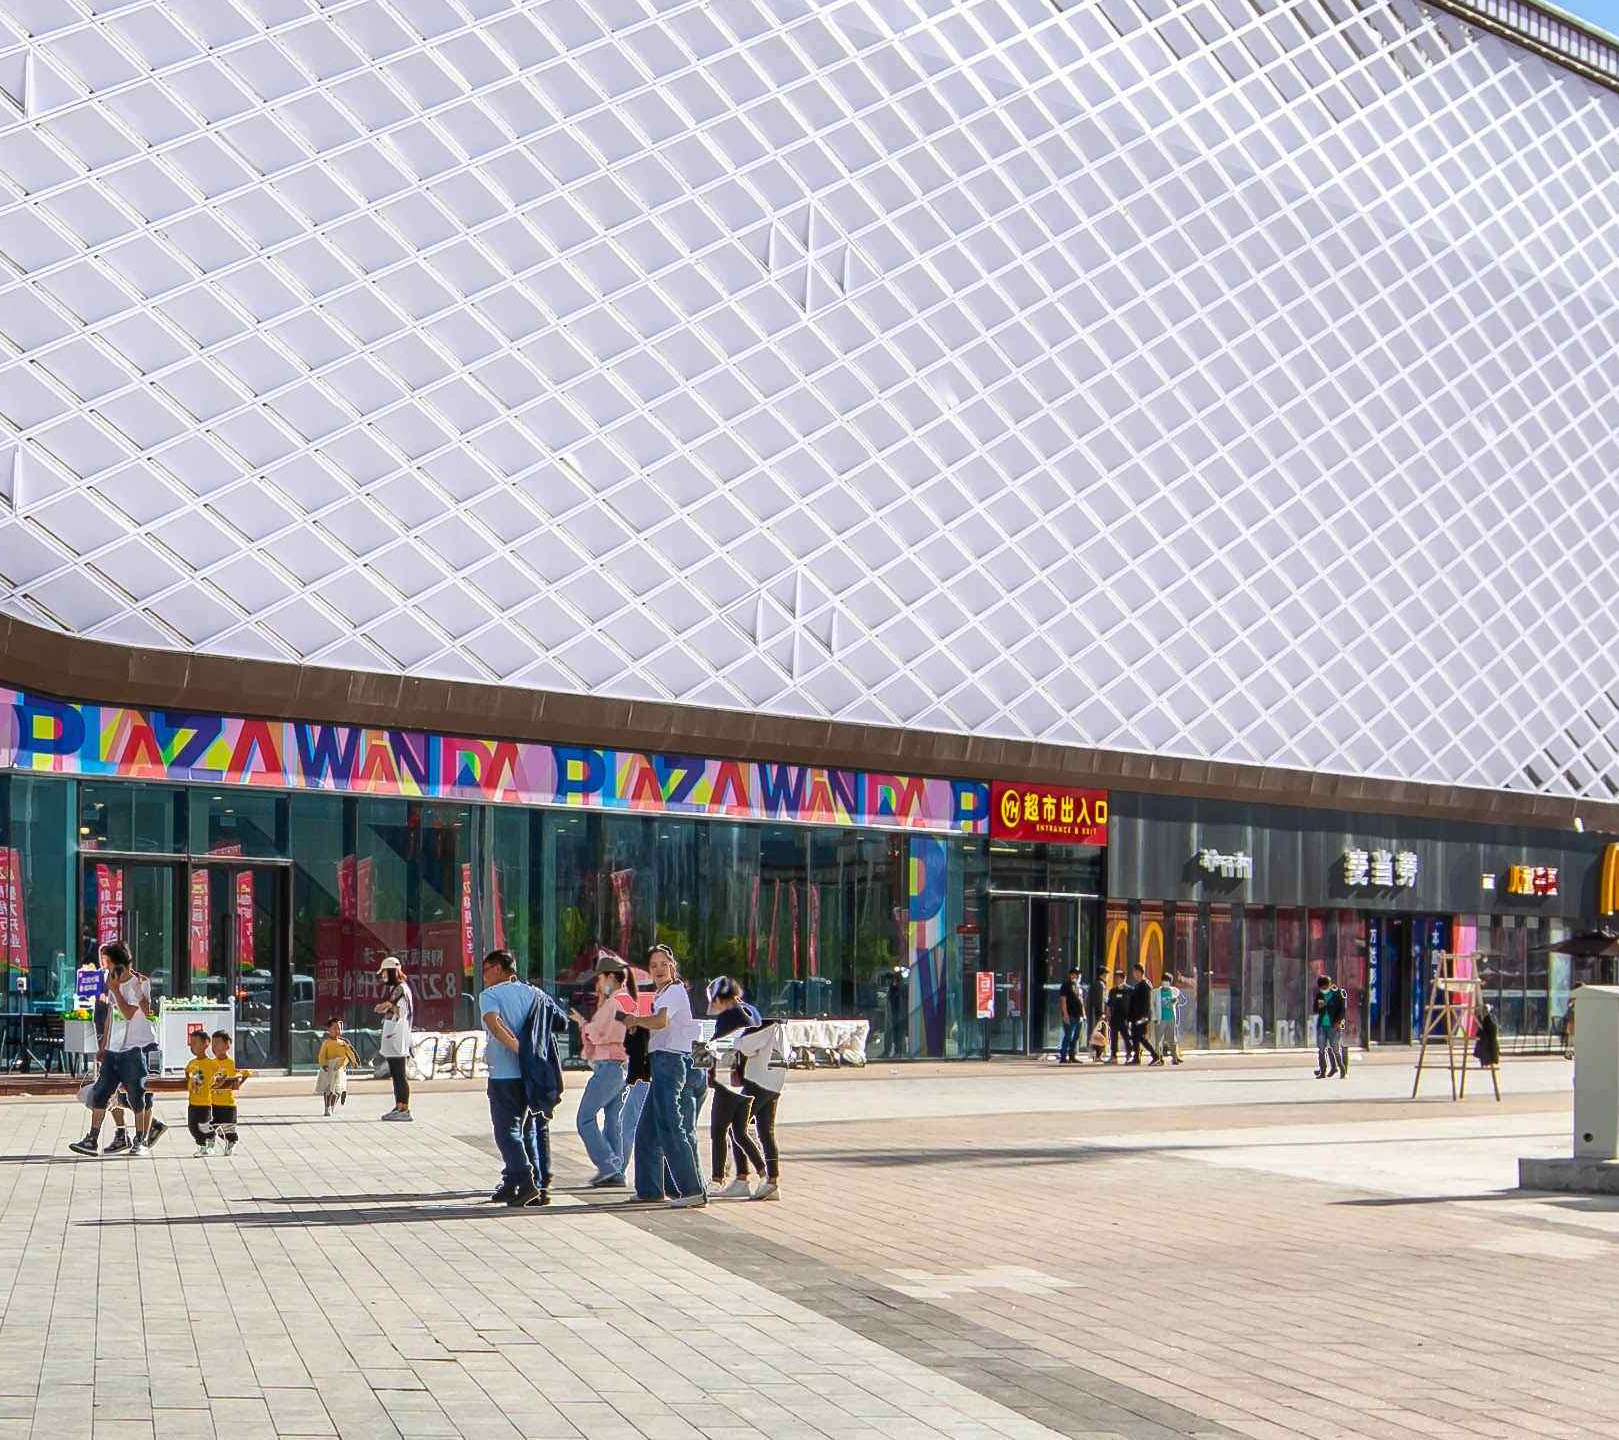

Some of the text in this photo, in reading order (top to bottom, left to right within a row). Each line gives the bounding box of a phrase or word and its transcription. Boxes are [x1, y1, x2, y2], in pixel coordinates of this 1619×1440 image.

[14, 703, 283, 786] PLAZA
[293, 721, 752, 816] WANDA PLAZA
[759, 762, 929, 830] WANDA
[1024, 792, 1107, 826] 超市出入口
[1344, 848, 1418, 888] 麦当劳
